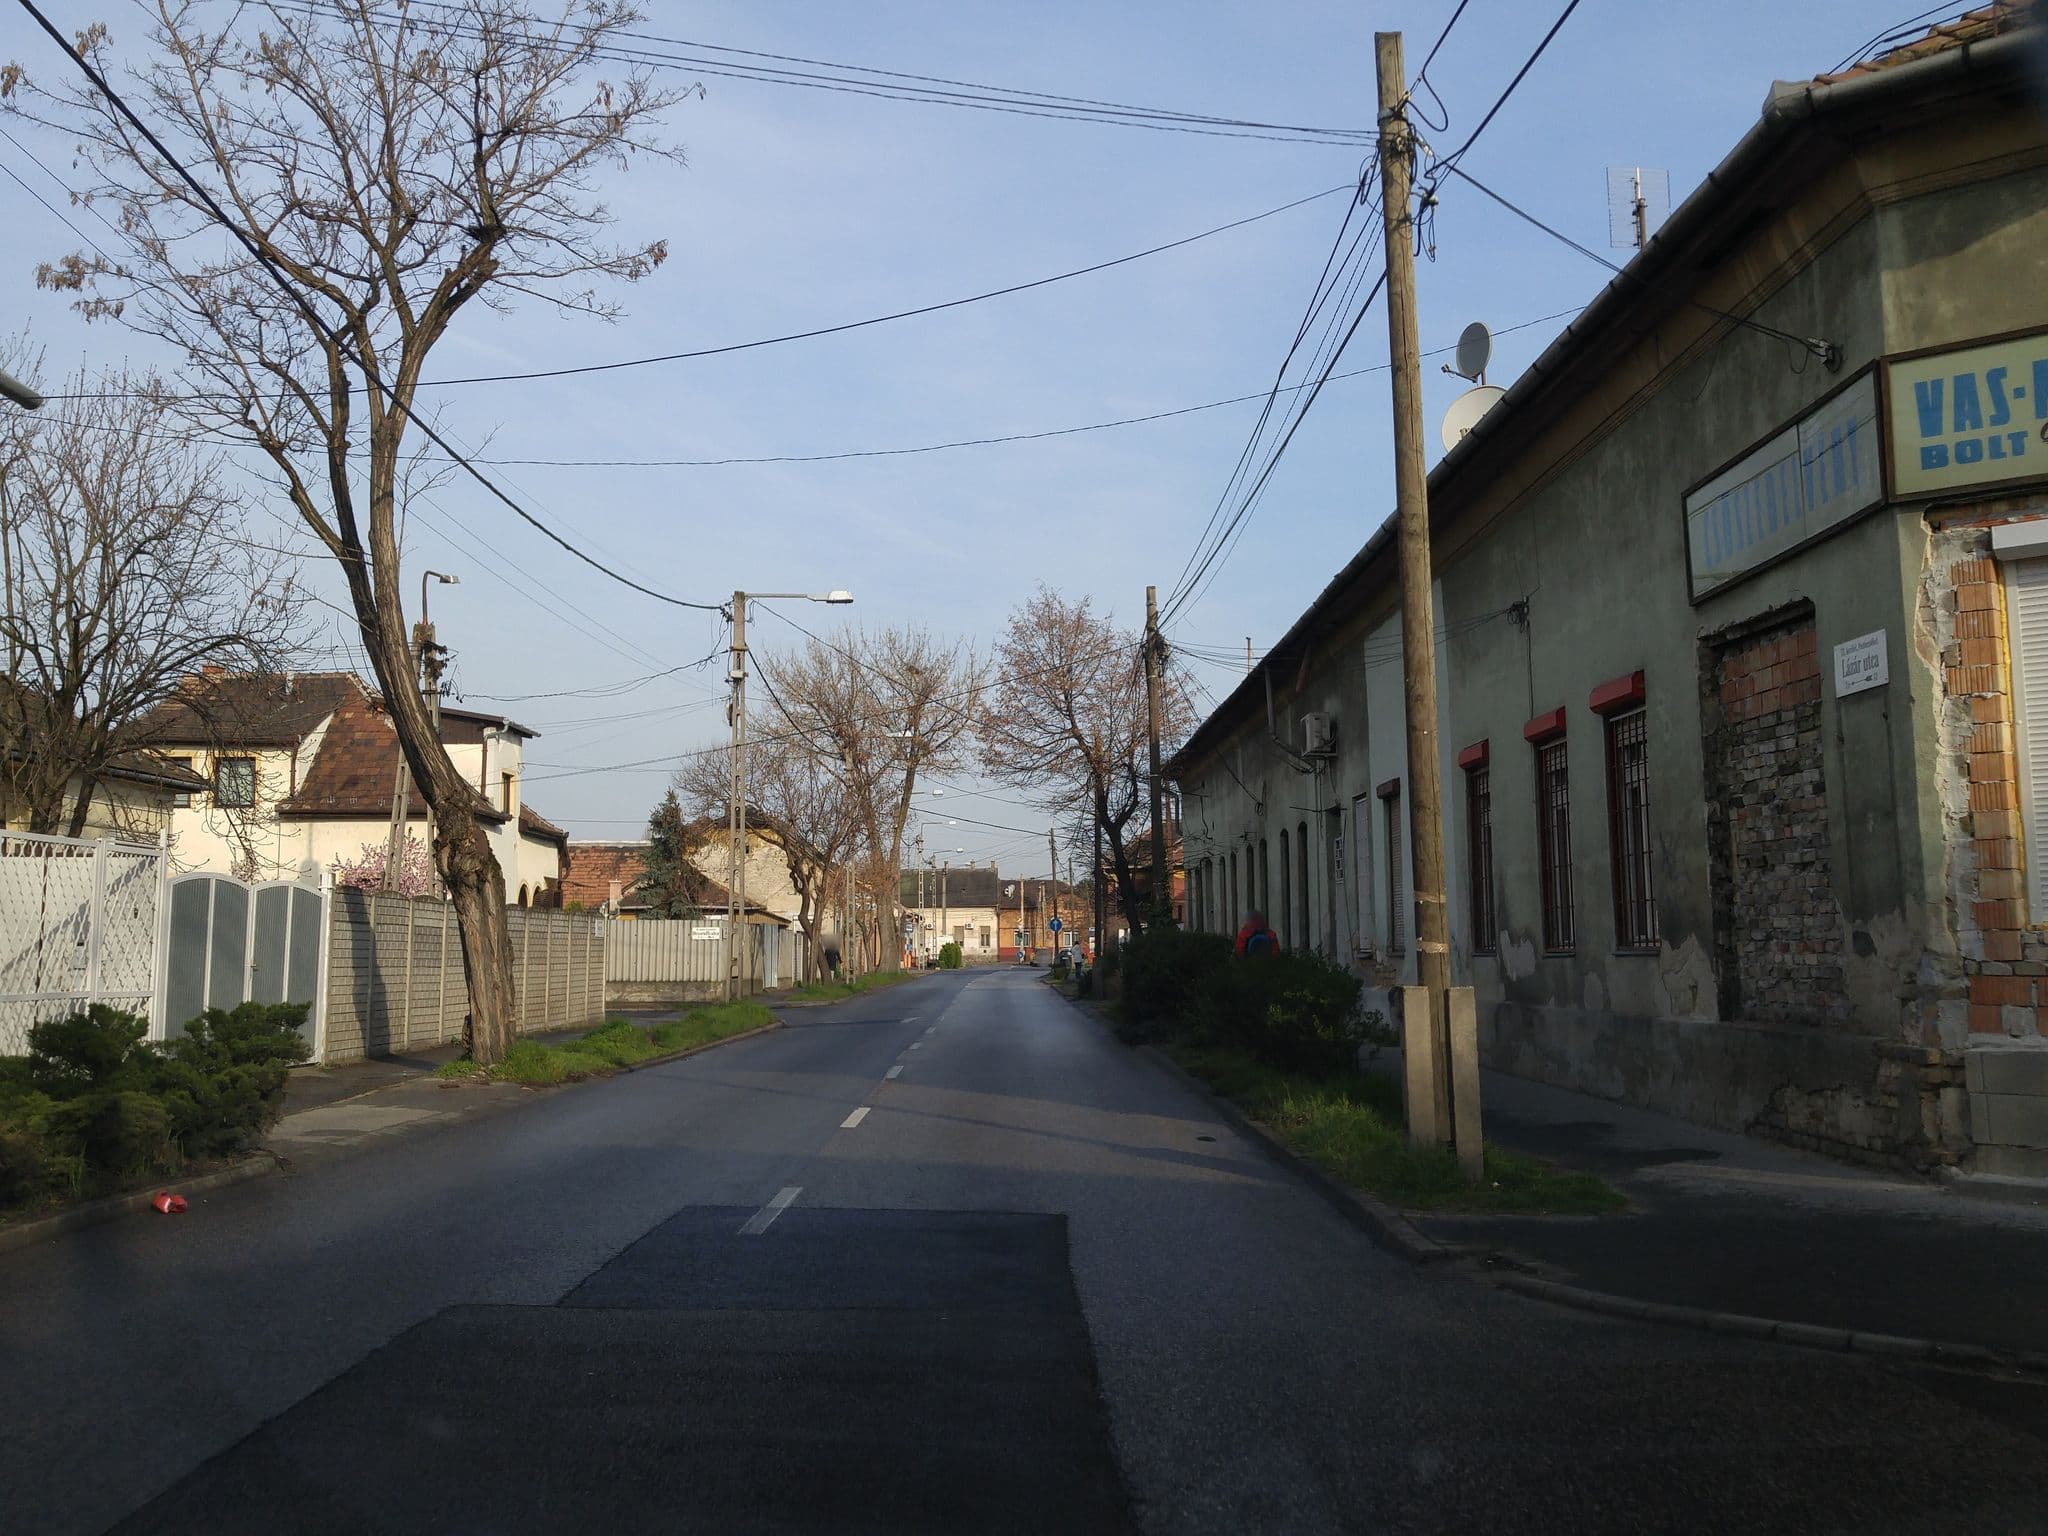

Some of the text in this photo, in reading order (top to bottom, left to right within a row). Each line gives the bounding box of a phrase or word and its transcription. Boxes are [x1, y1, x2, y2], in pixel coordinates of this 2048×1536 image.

[1920, 430, 2028, 470] BOLT
[1842, 656, 1862, 677] Lázár
[1863, 654, 1879, 671] utca
